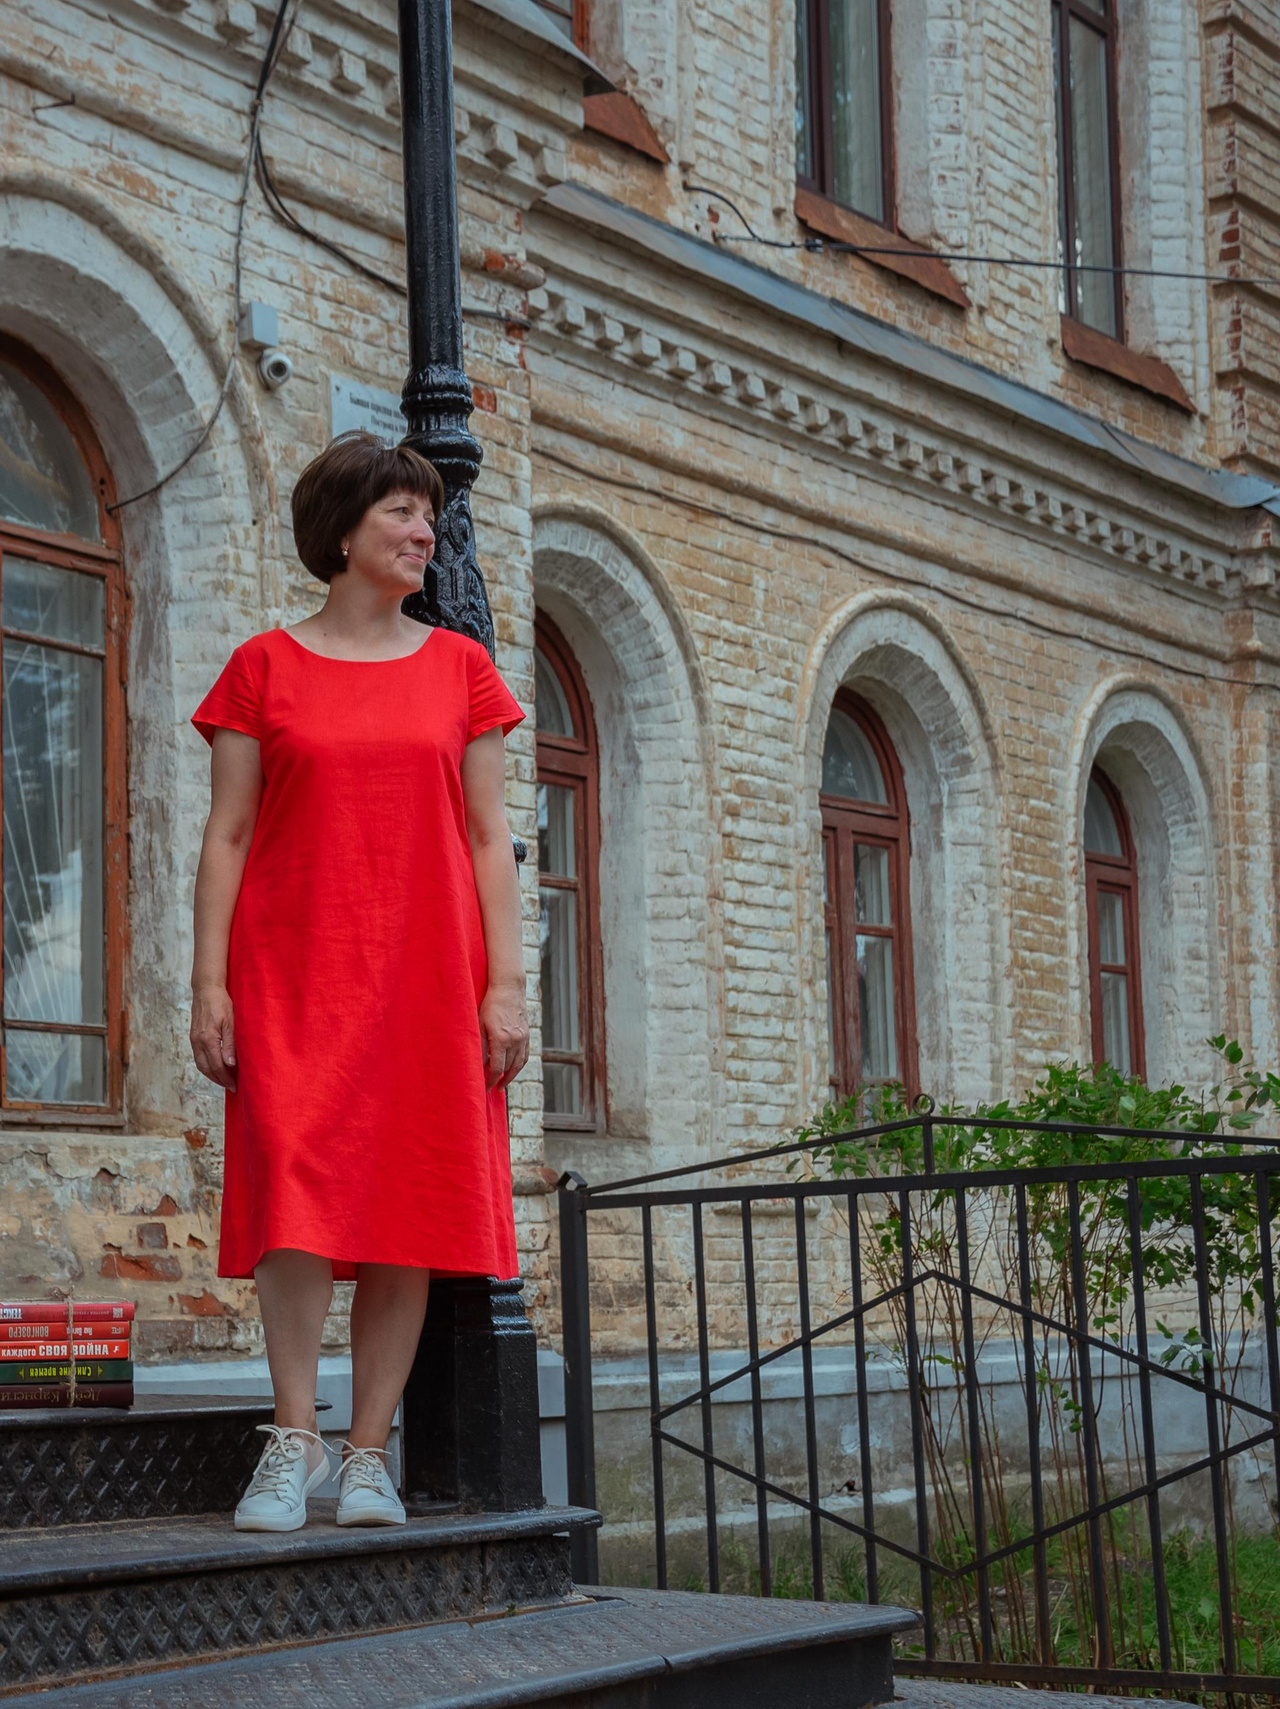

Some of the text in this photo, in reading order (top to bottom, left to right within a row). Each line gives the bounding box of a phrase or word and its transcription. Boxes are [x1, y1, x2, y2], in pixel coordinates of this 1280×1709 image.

[0, 1308, 22, 1320] ТЕКСТ
[9, 1325, 49, 1338] ВОНГОЗЕРО
[38, 1345, 68, 1356] СВОЯ
[72, 1342, 109, 1356] ВОЙНА
[29, 1366, 92, 1378] Слиние времен
[0, 1387, 60, 1403] Карнеги
